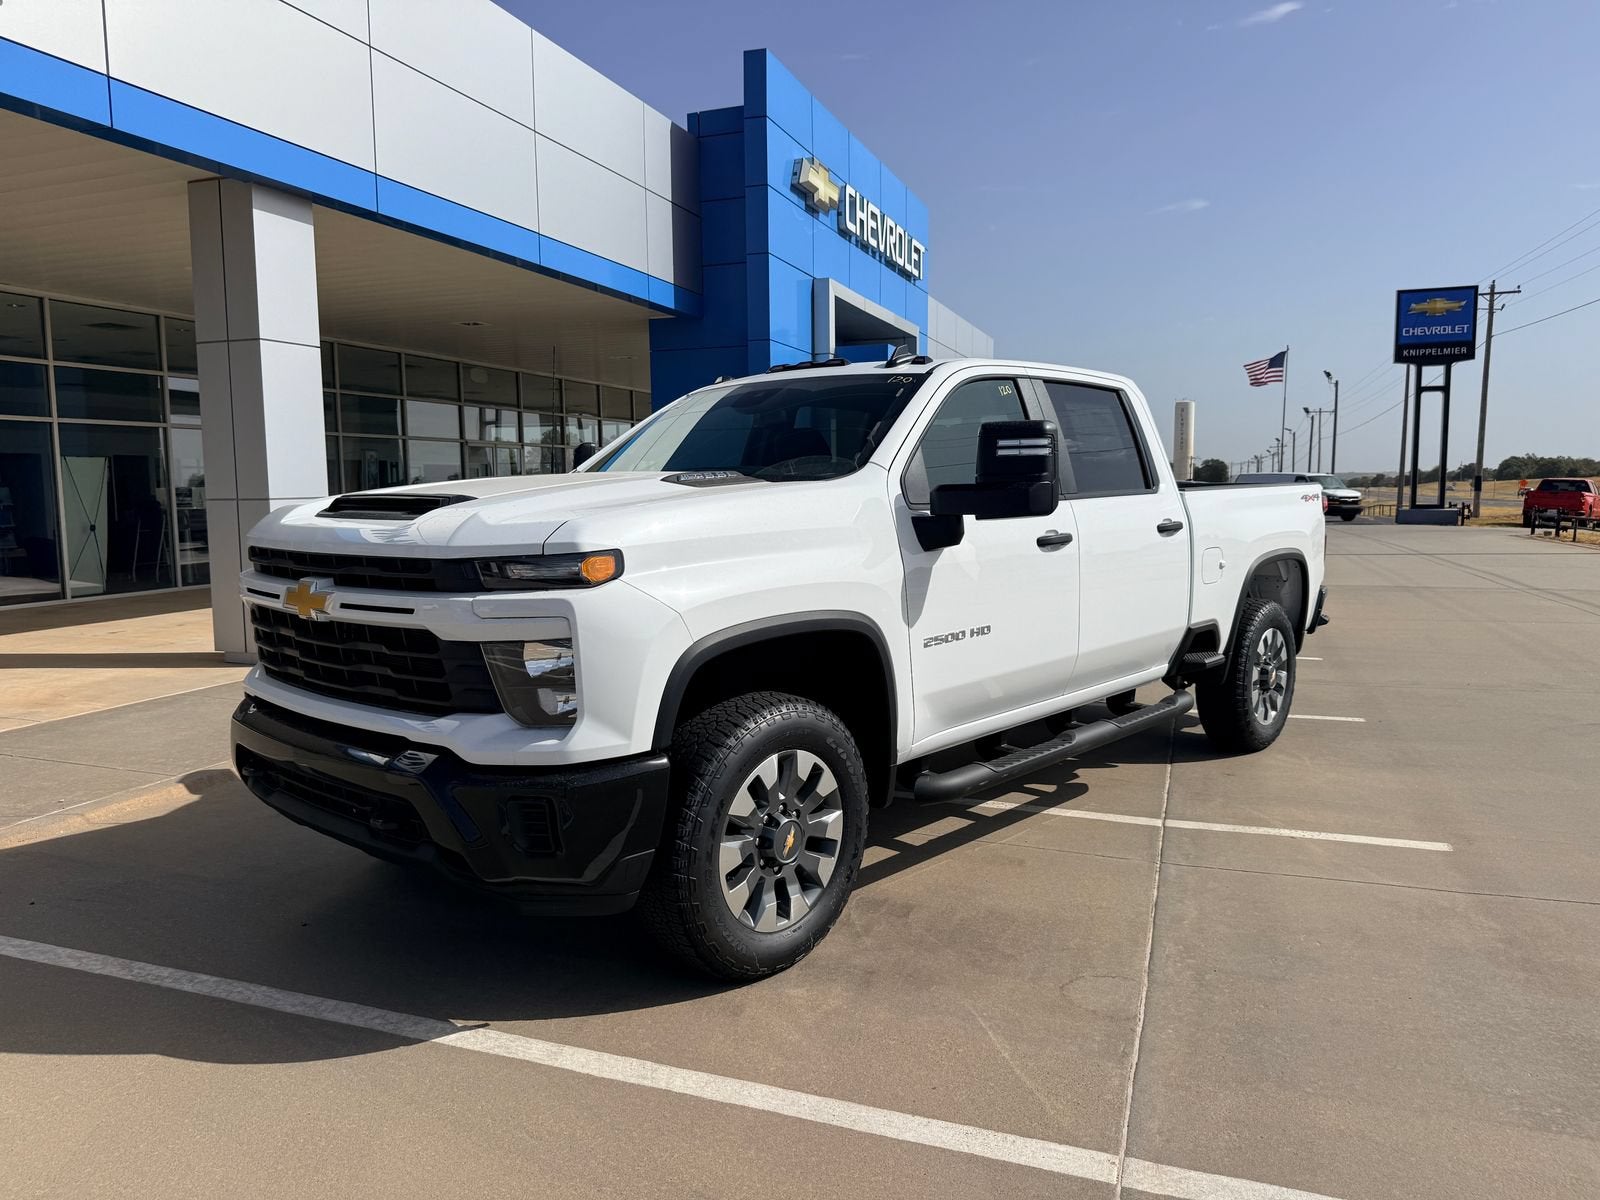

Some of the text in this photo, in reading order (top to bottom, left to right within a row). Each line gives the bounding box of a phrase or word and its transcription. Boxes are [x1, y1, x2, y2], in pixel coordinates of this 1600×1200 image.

[843, 184, 926, 280] CHEVROLET
[1402, 324, 1470, 336] CHEVROLET
[1403, 346, 1467, 357] KNIPPELMIER
[887, 375, 913, 384] 120
[998, 385, 1012, 397] 120
[922, 624, 991, 649] 2500 HD
